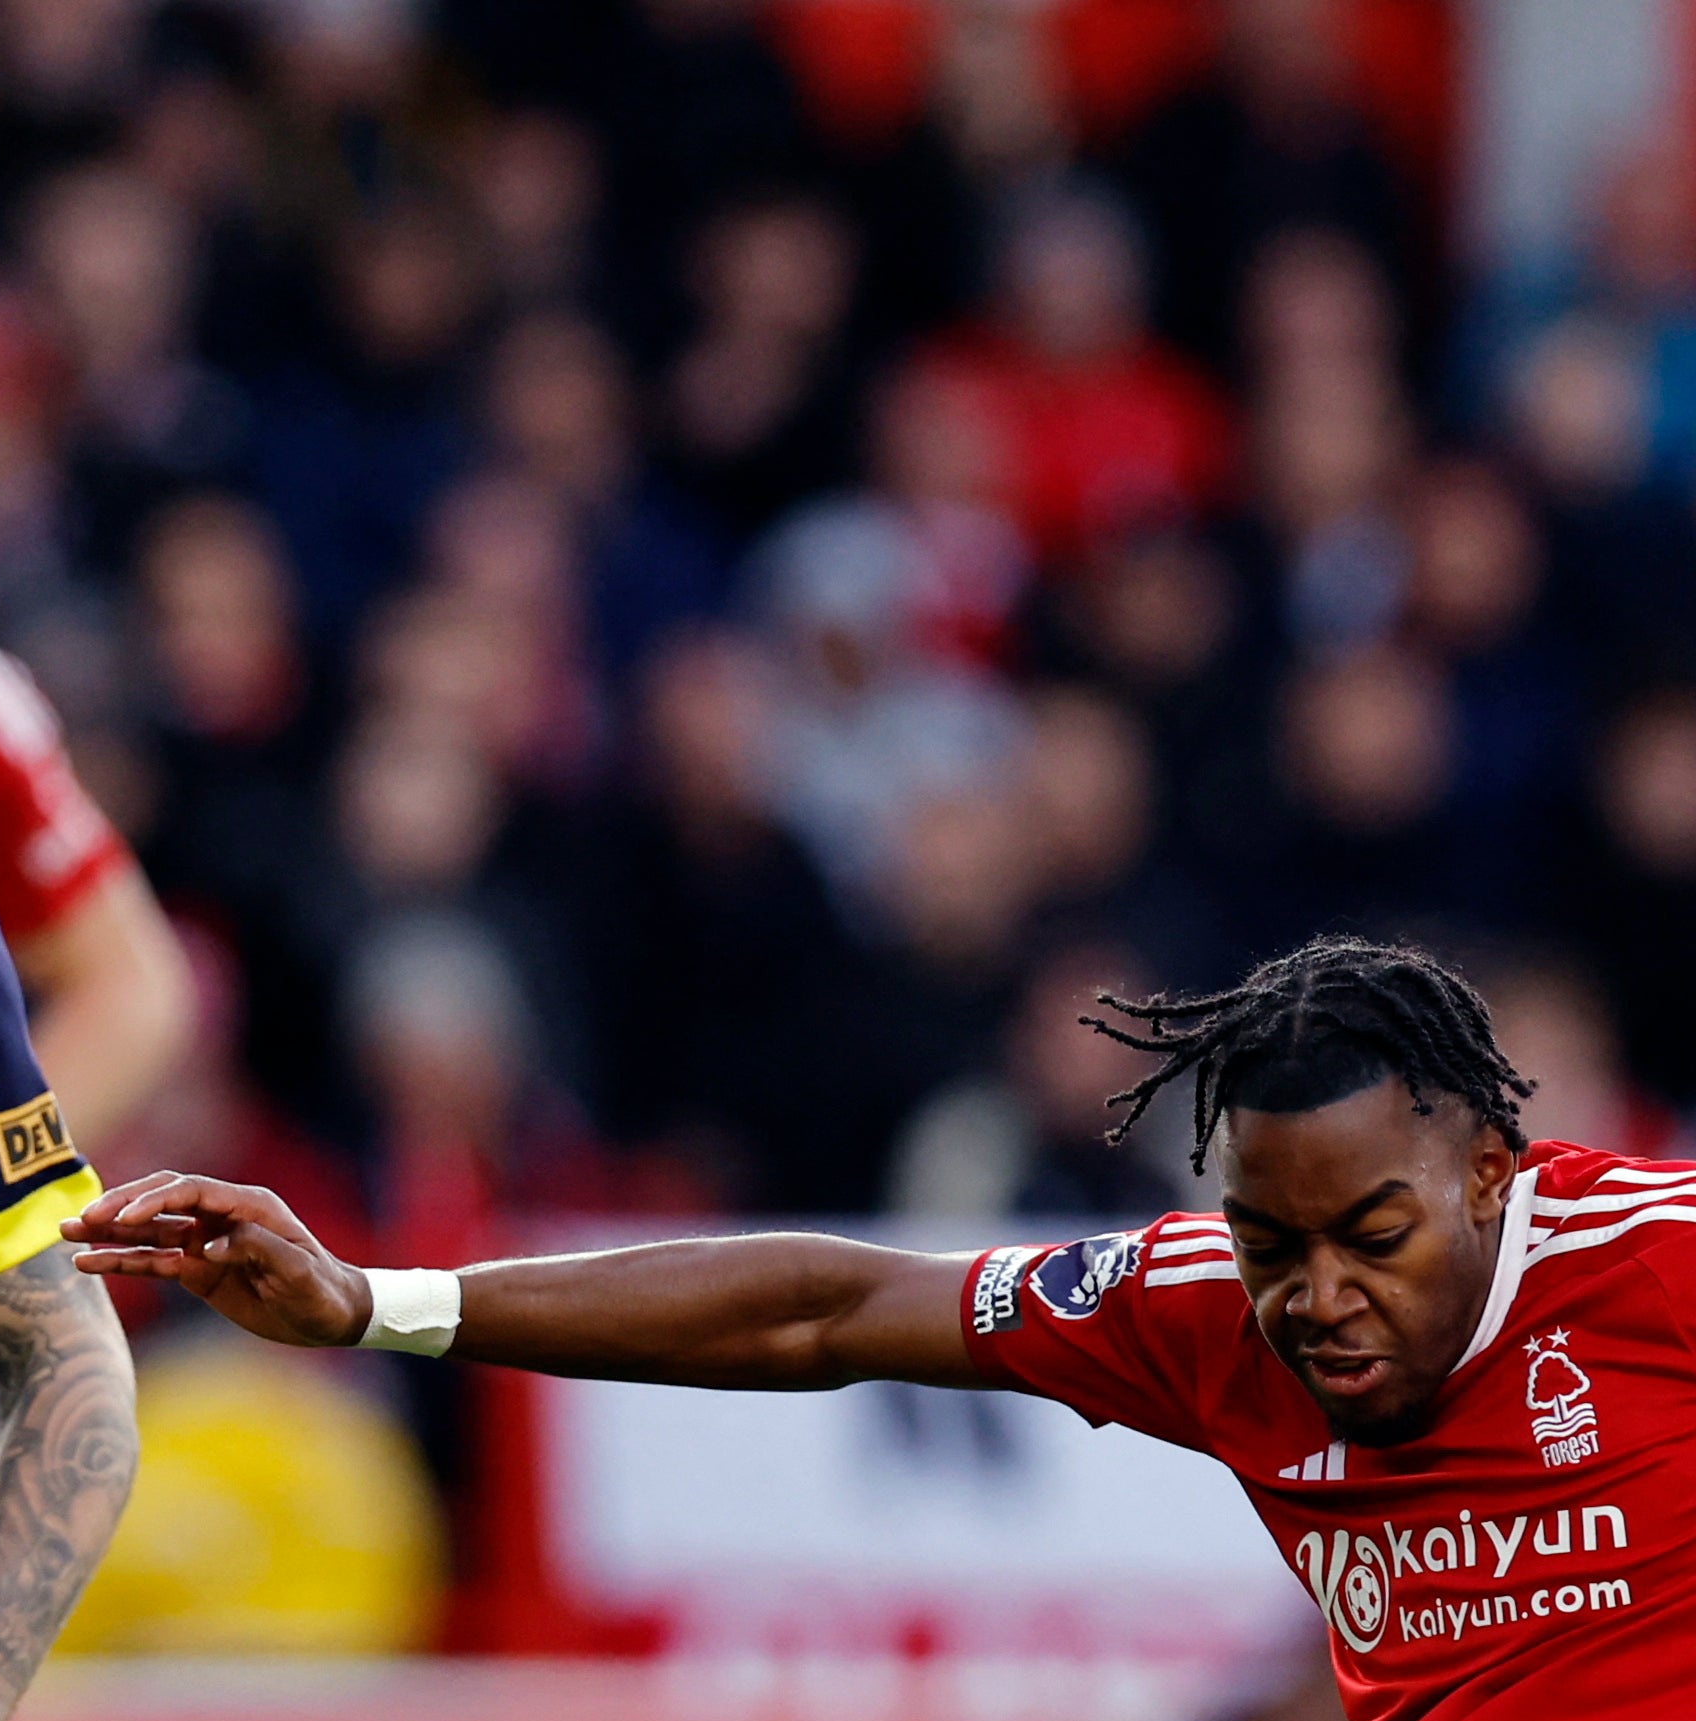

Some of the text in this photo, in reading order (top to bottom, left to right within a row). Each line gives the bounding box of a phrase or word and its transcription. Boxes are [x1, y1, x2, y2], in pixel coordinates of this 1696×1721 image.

[973, 1262, 1003, 1335] racism
[1384, 1504, 1629, 1579] kaiyun
[1398, 1576, 1632, 1643] kaiyun.com
